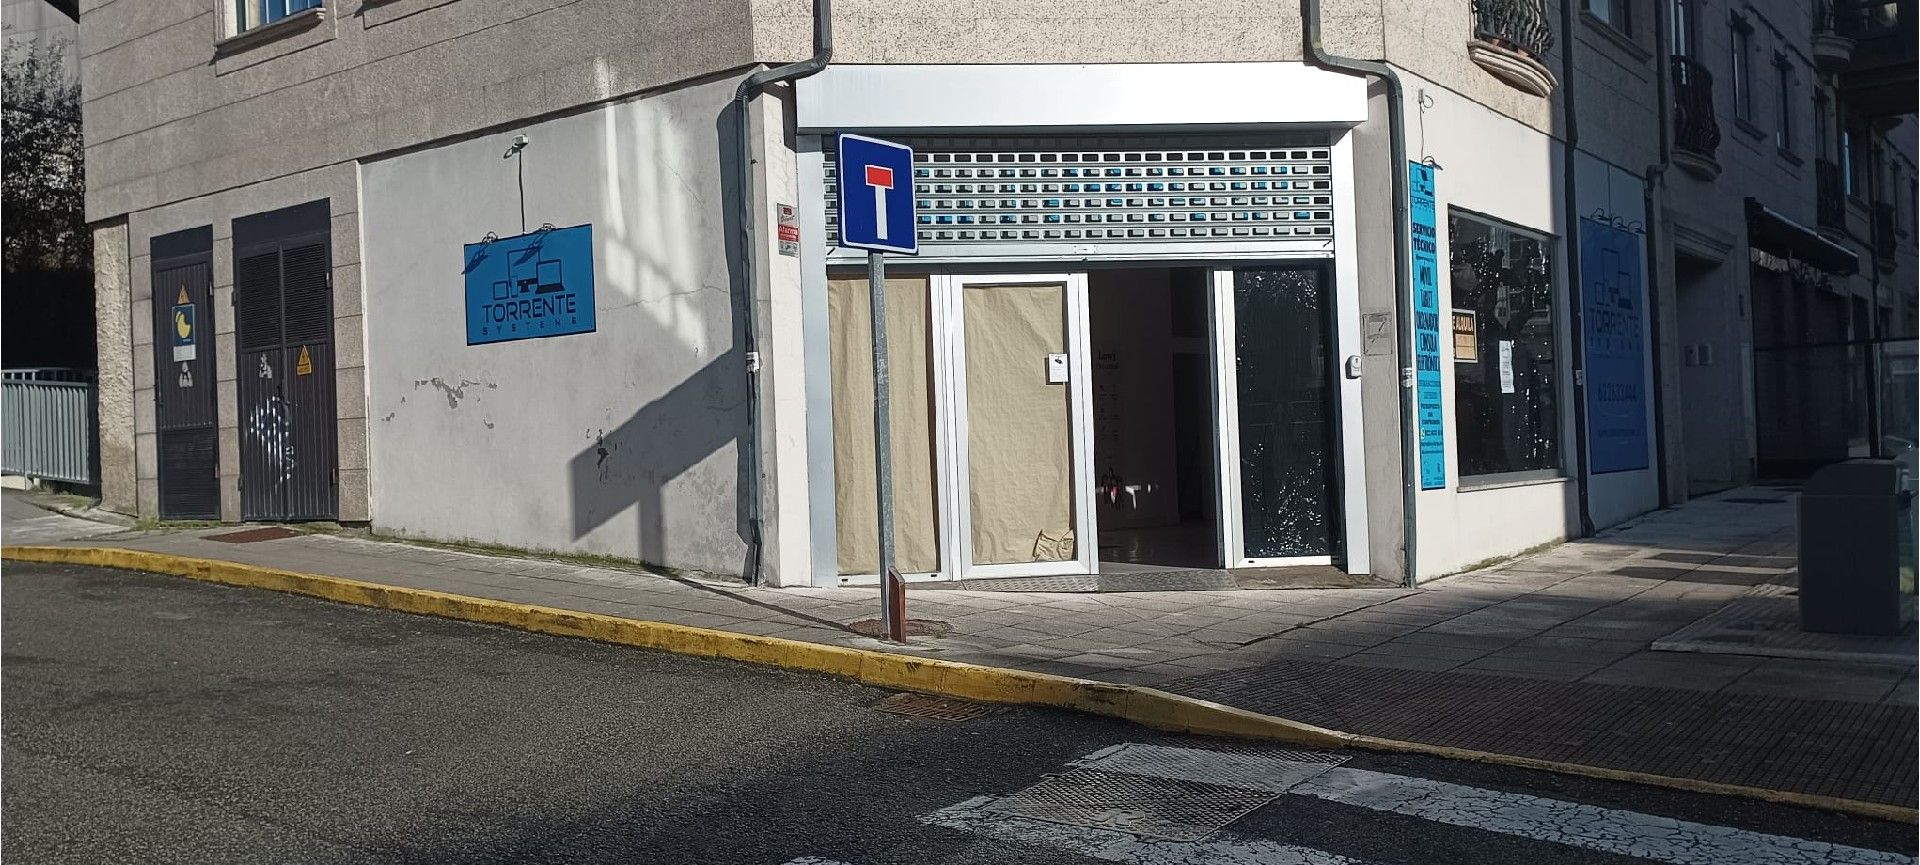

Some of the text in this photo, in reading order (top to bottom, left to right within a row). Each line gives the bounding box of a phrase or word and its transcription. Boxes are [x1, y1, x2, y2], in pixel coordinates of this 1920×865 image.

[1414, 236, 1436, 254] TÉCNICO
[482, 293, 576, 323] TORRENTE
[1588, 306, 1640, 339] TORRENTE
